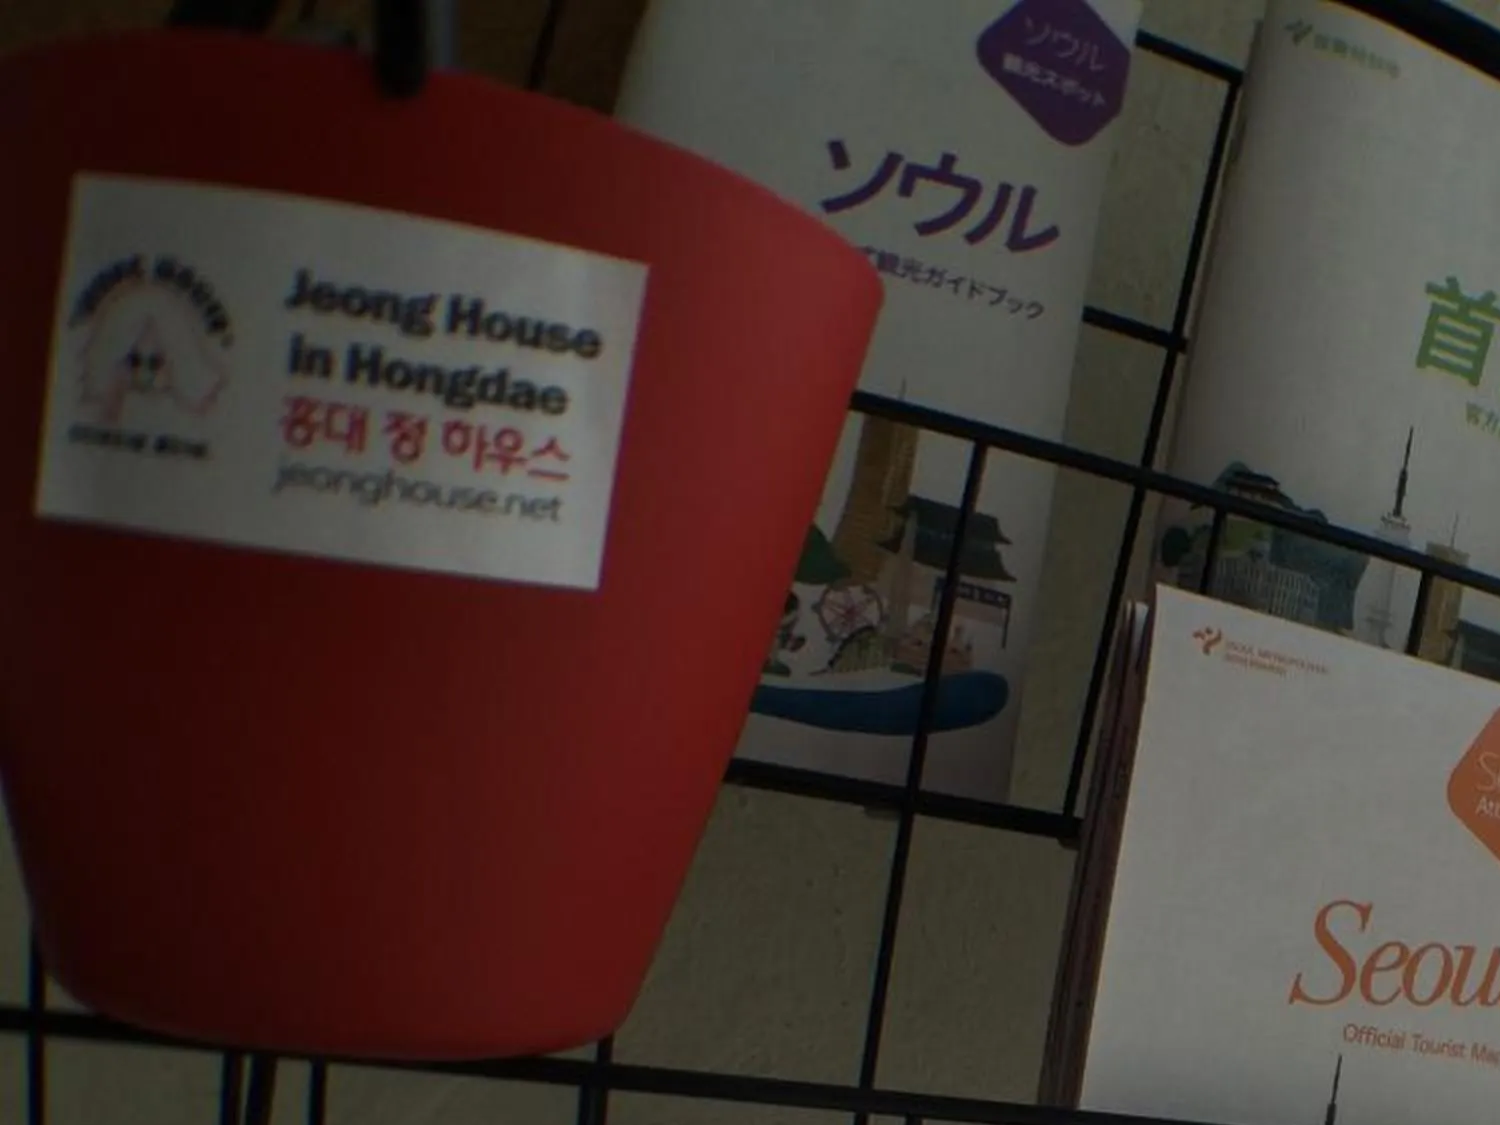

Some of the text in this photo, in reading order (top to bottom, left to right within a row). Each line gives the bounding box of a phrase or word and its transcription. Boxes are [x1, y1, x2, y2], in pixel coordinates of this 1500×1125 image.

[1023, 14, 1107, 73] ソウル
[820, 139, 1060, 253] ソウル
[284, 267, 441, 339] Jeong
[444, 293, 604, 359] House
[858, 244, 1046, 321] 観光ガイドブック
[345, 341, 569, 416] Hongdae
[281, 395, 571, 481] 홍대 정 하우스
[271, 457, 566, 522] jeonghouse.net
[1342, 1023, 1406, 1050] Official
[1411, 1033, 1467, 1059] Tourist
